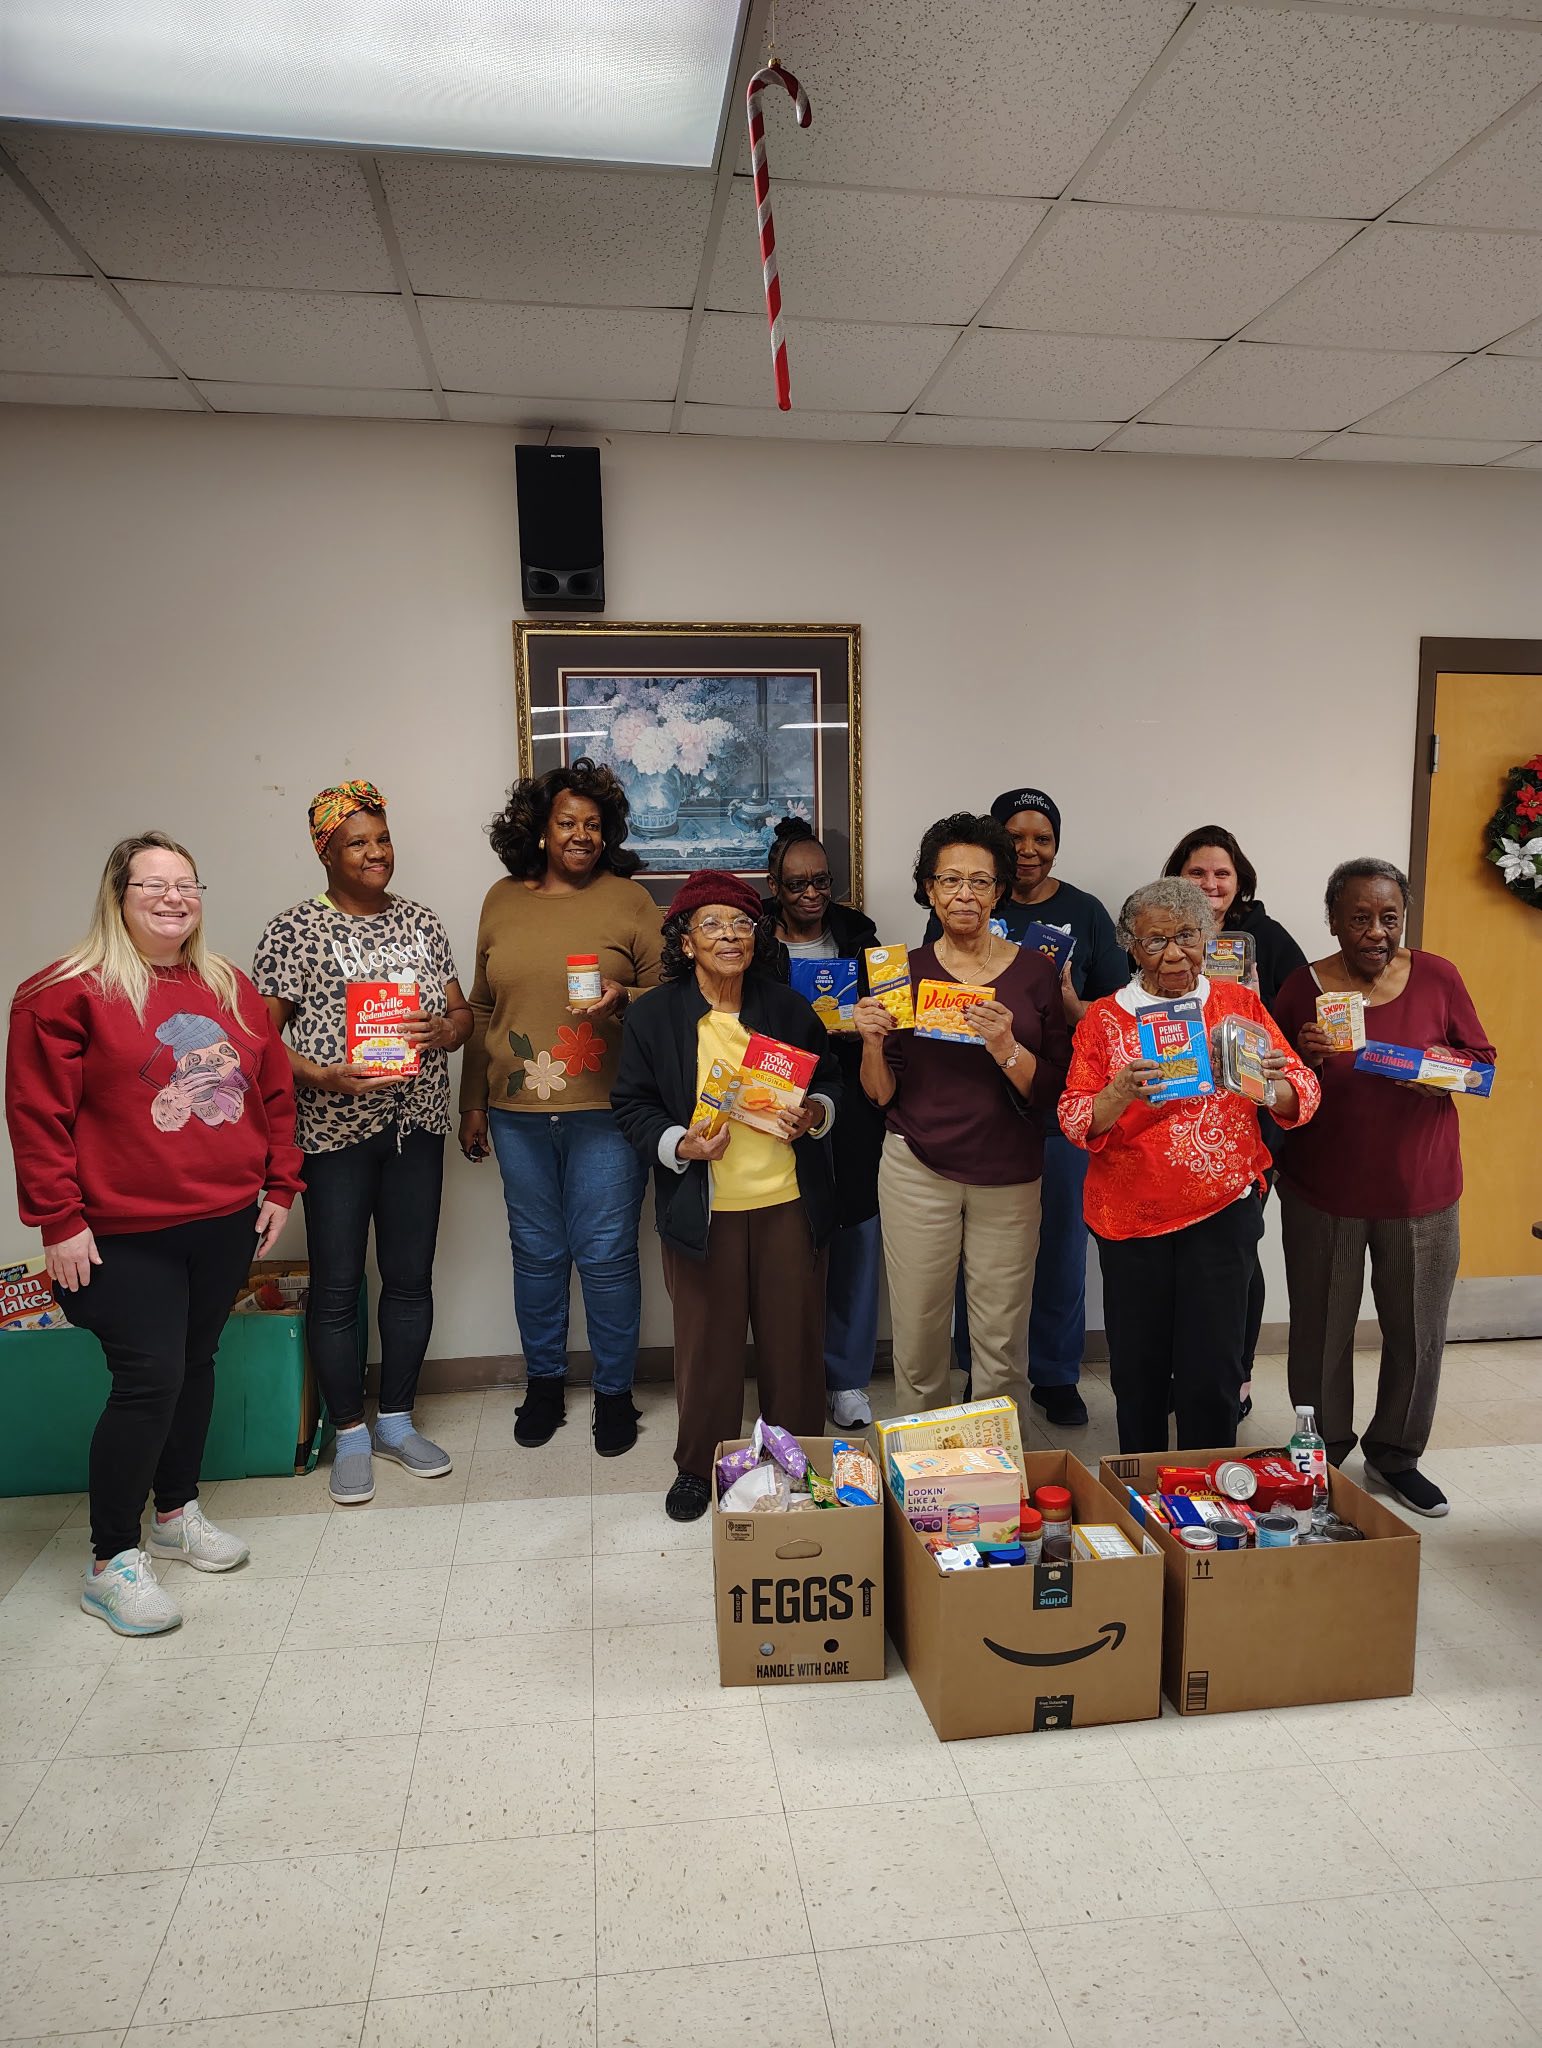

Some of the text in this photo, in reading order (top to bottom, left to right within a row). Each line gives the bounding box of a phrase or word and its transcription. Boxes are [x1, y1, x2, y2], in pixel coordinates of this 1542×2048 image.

[332, 929, 433, 978] blessed
[848, 961, 857, 972] 5
[363, 996, 403, 1012] Orville
[1322, 1003, 1346, 1016] SKIPPY
[358, 1025, 381, 1034] MINI
[1159, 1023, 1183, 1035] PENNE
[1160, 1032, 1186, 1045] RIGATE
[763, 1052, 795, 1071] TOWN
[1363, 1051, 1415, 1070] COLUMBIA
[759, 1060, 792, 1080] HOUSE
[755, 1073, 788, 1089] ORIGINAL
[908, 1488, 946, 1497] LOOKIN'
[908, 1505, 943, 1513] SNACK.
[752, 1574, 853, 1624] EGGS
[1040, 1595, 1068, 1606] prime
[756, 1661, 850, 1679] HANDLE WITH CARE
